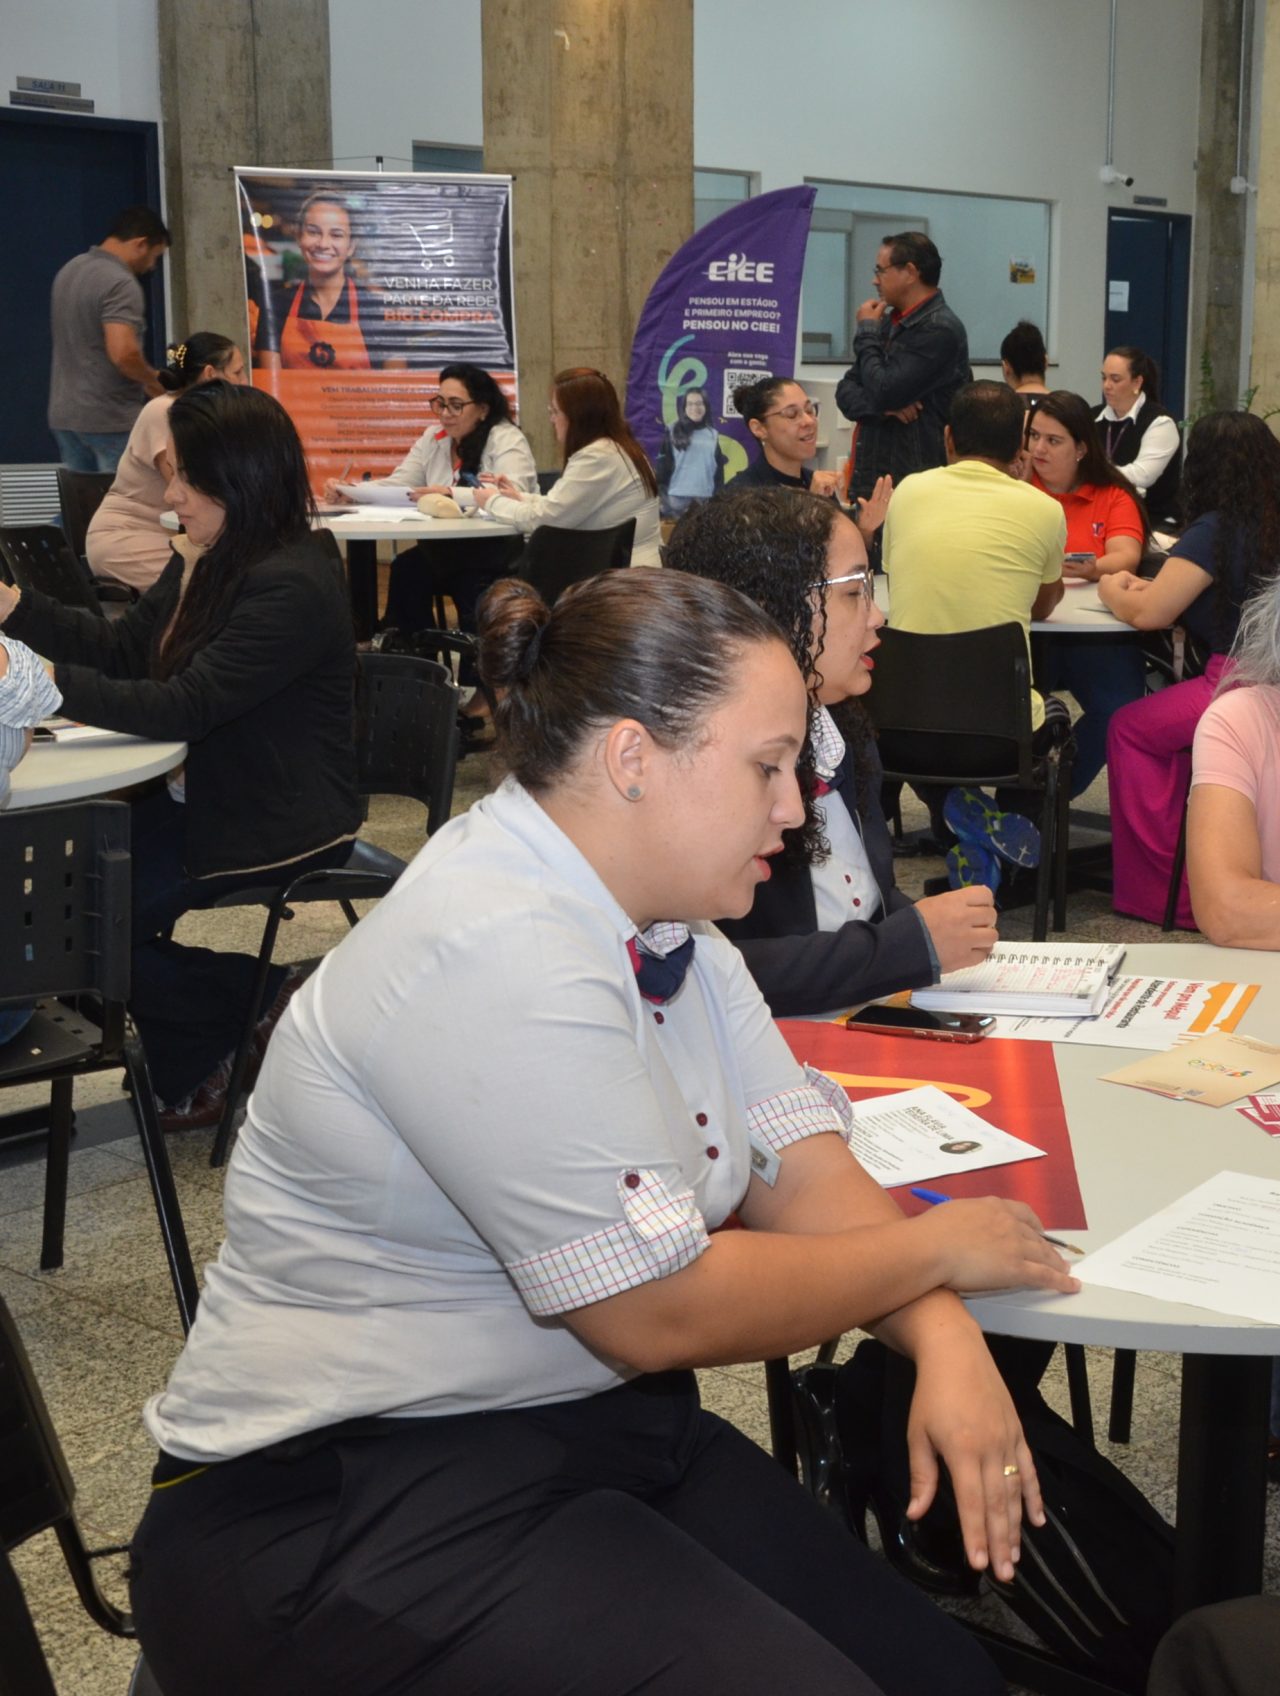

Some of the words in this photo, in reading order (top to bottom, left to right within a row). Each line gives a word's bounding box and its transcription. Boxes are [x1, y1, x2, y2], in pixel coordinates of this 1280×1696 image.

[32, 80, 54, 90] SALA
[384, 276, 440, 290] VENHA
[443, 278, 493, 291] FAZER
[383, 293, 429, 306] PARTE
[432, 295, 454, 307] DA
[456, 296, 495, 307] REDE
[689, 297, 725, 306] PENSOU
[726, 298, 740, 306] EM
[741, 298, 778, 308] ESTÁGIO
[419, 309, 497, 325] COMPRA
[684, 308, 691, 317] E
[692, 309, 733, 318] PRIMEIRO
[734, 310, 781, 320] EMPREGO?
[683, 320, 730, 331] PENSOU
[731, 321, 749, 331] NO
[750, 321, 780, 334] CIEE!
[1184, 982, 1204, 993] Vem
